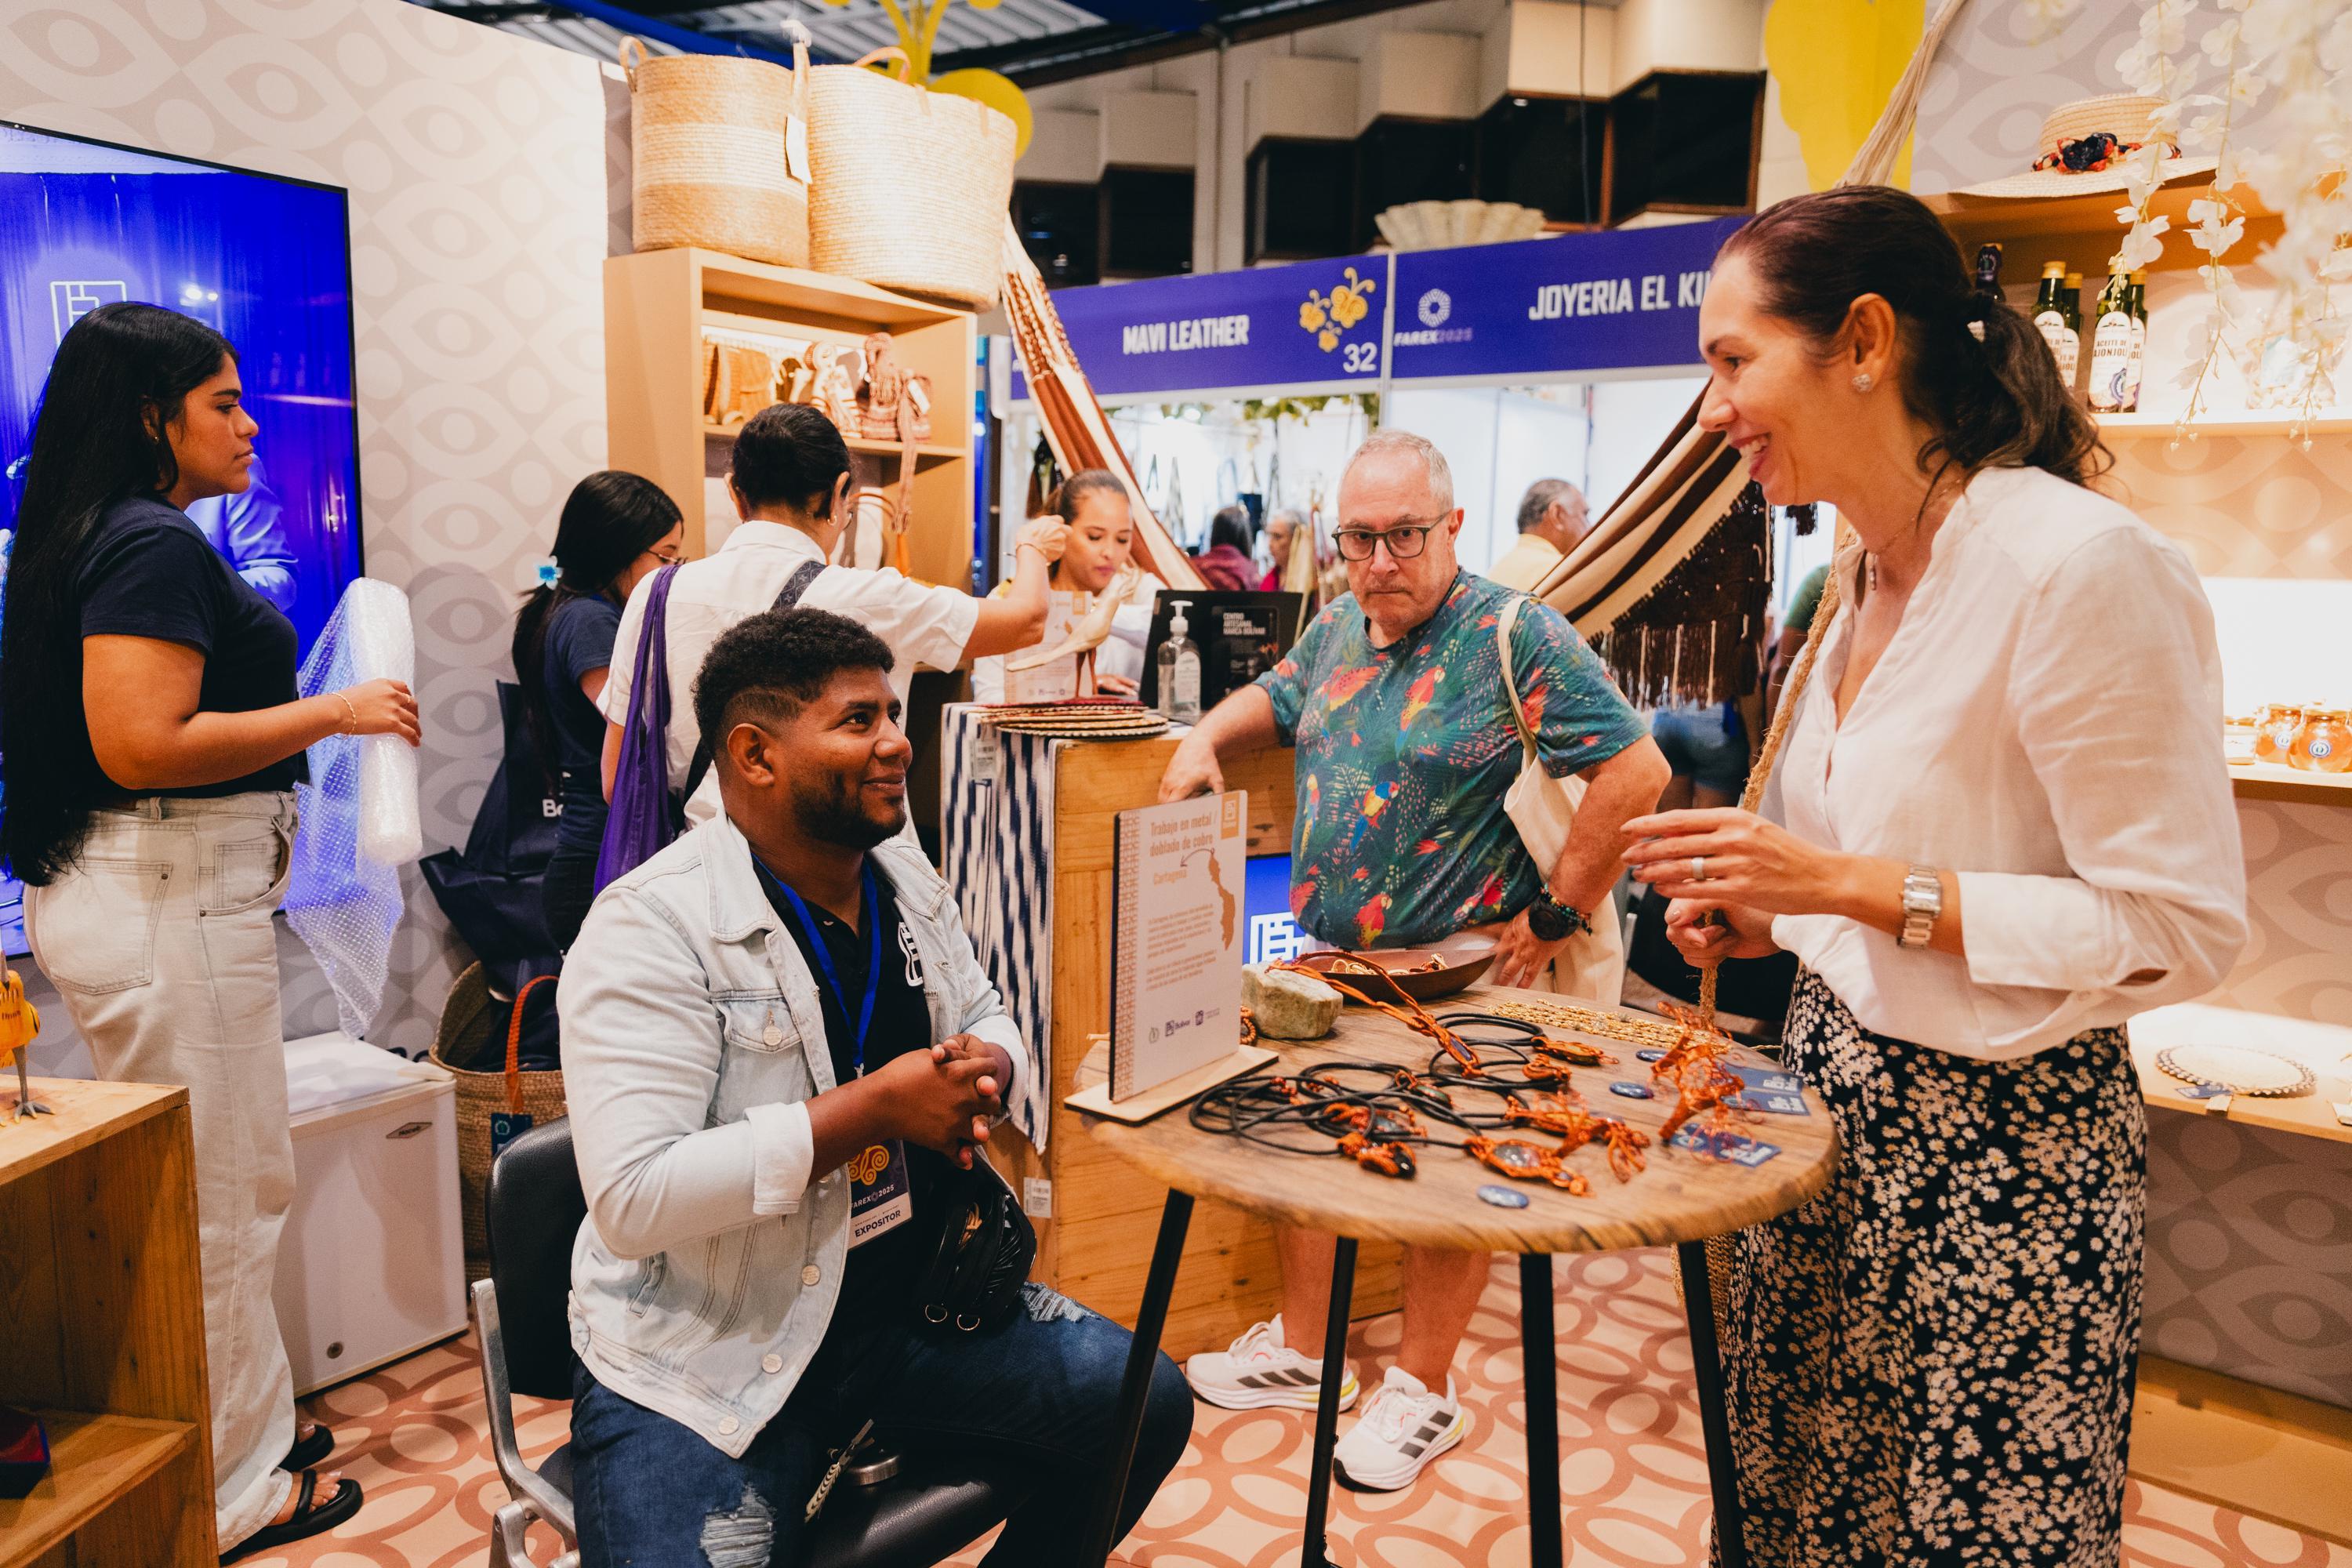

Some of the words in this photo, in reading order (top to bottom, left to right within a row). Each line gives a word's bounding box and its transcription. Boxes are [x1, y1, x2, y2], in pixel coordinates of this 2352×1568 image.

[1529, 278, 1633, 320] JOYERIA
[1642, 275, 1670, 310] EL
[1123, 322, 1167, 354] MAVI
[1169, 315, 1250, 351] LEATHER
[1342, 343, 1377, 374] 32
[1150, 821, 1178, 837] Trabajo
[1180, 818, 1189, 830] en
[1191, 812, 1211, 828] metal
[1149, 840, 1180, 856] doblado
[1181, 836, 1191, 849] de
[1192, 833, 1214, 848] cobre
[878, 1185, 895, 1197] 2025
[855, 1210, 901, 1238] EXPOSITOR
